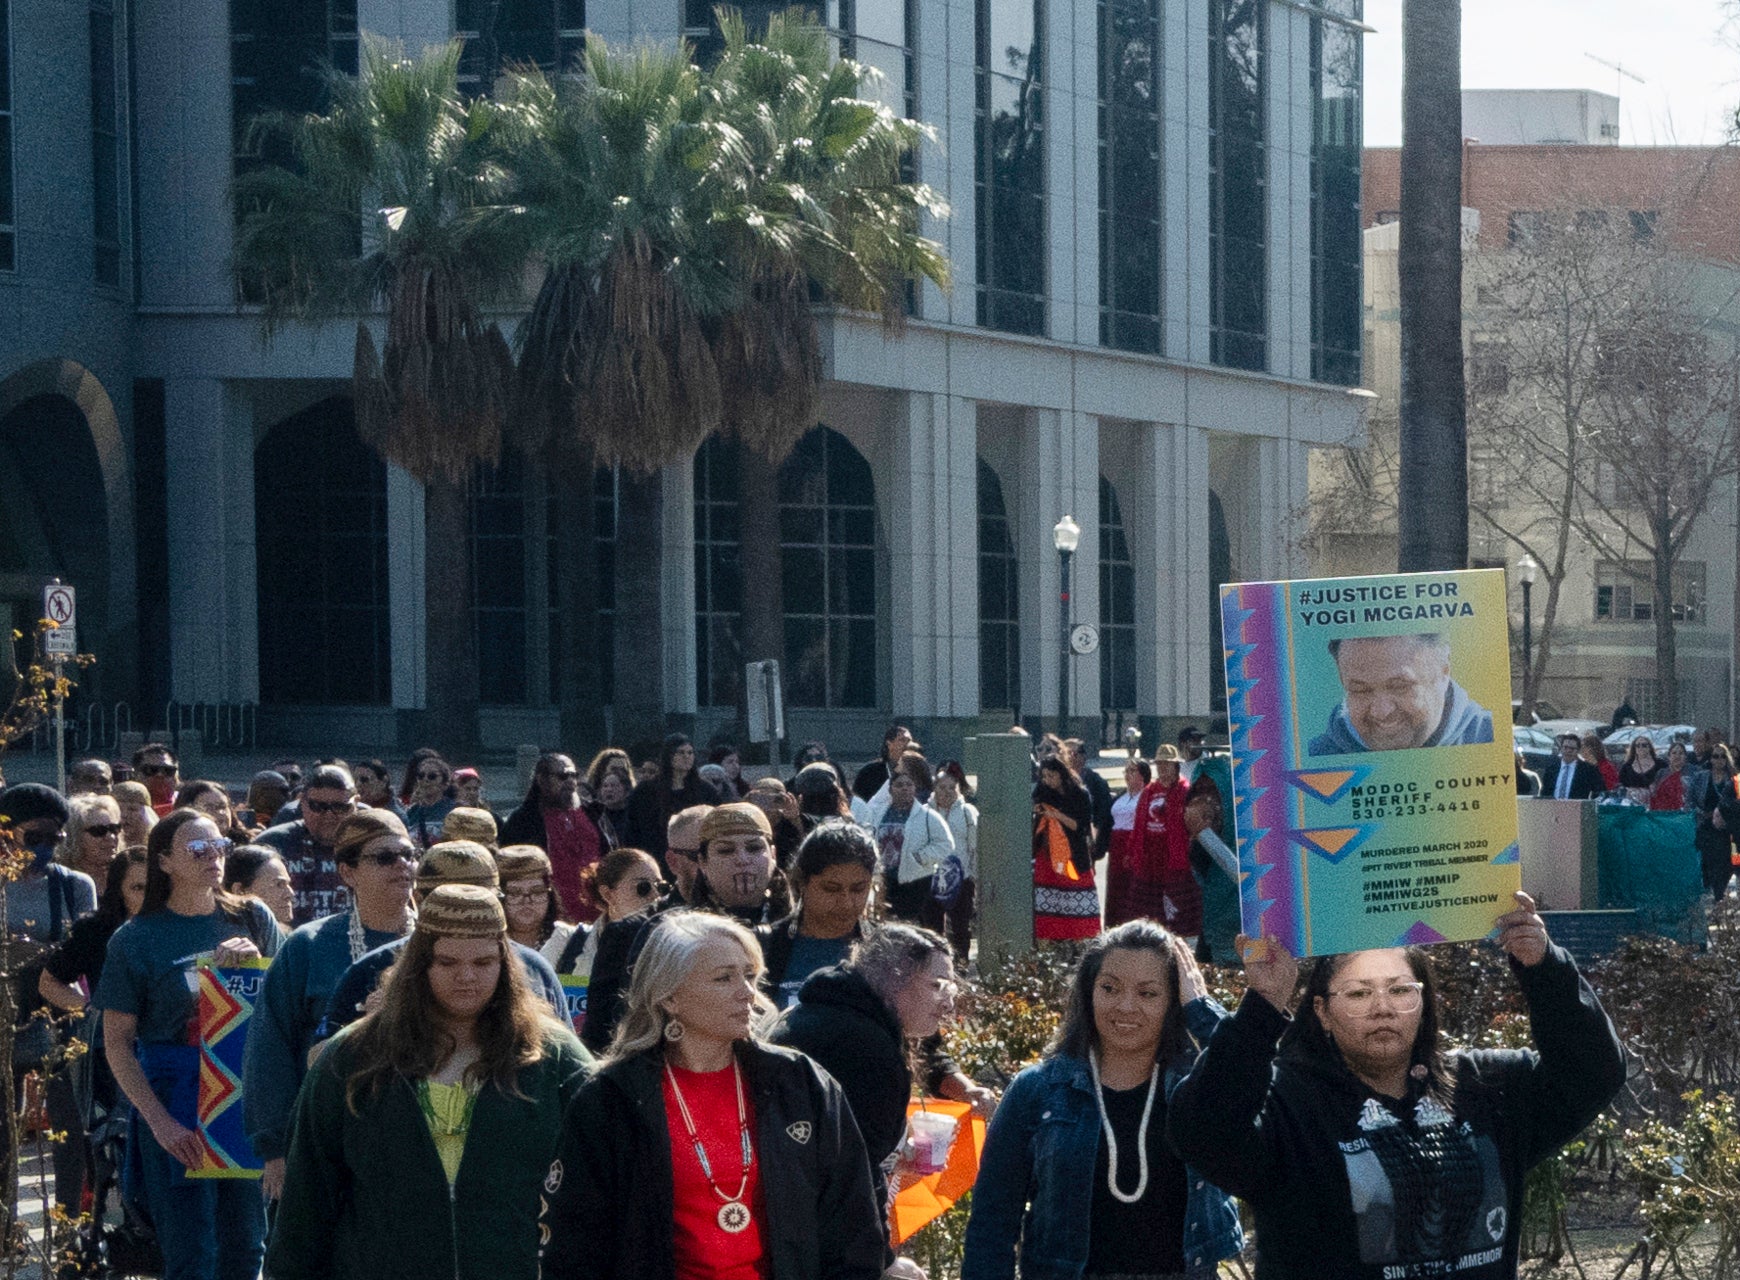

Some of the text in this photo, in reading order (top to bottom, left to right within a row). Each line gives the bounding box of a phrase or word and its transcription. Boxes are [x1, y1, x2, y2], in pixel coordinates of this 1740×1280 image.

[1300, 582, 1458, 606] #JUSTICE FOR
[1300, 602, 1474, 626] YOGI MCGARVA
[1351, 774, 1510, 797] MODOC COUNTY
[1352, 792, 1432, 808] SHERIFF
[1352, 800, 1481, 820] 530-233-4416
[1360, 839, 1489, 858] MURDERED MARCH 2020
[1384, 861, 1412, 871] RIVER
[1413, 858, 1447, 868] TRIBAL
[1448, 854, 1489, 865] MEMBER
[1363, 873, 1461, 891] #MMIW #MMIP
[1365, 894, 1499, 914] #NATIVEJUSTICENOW
